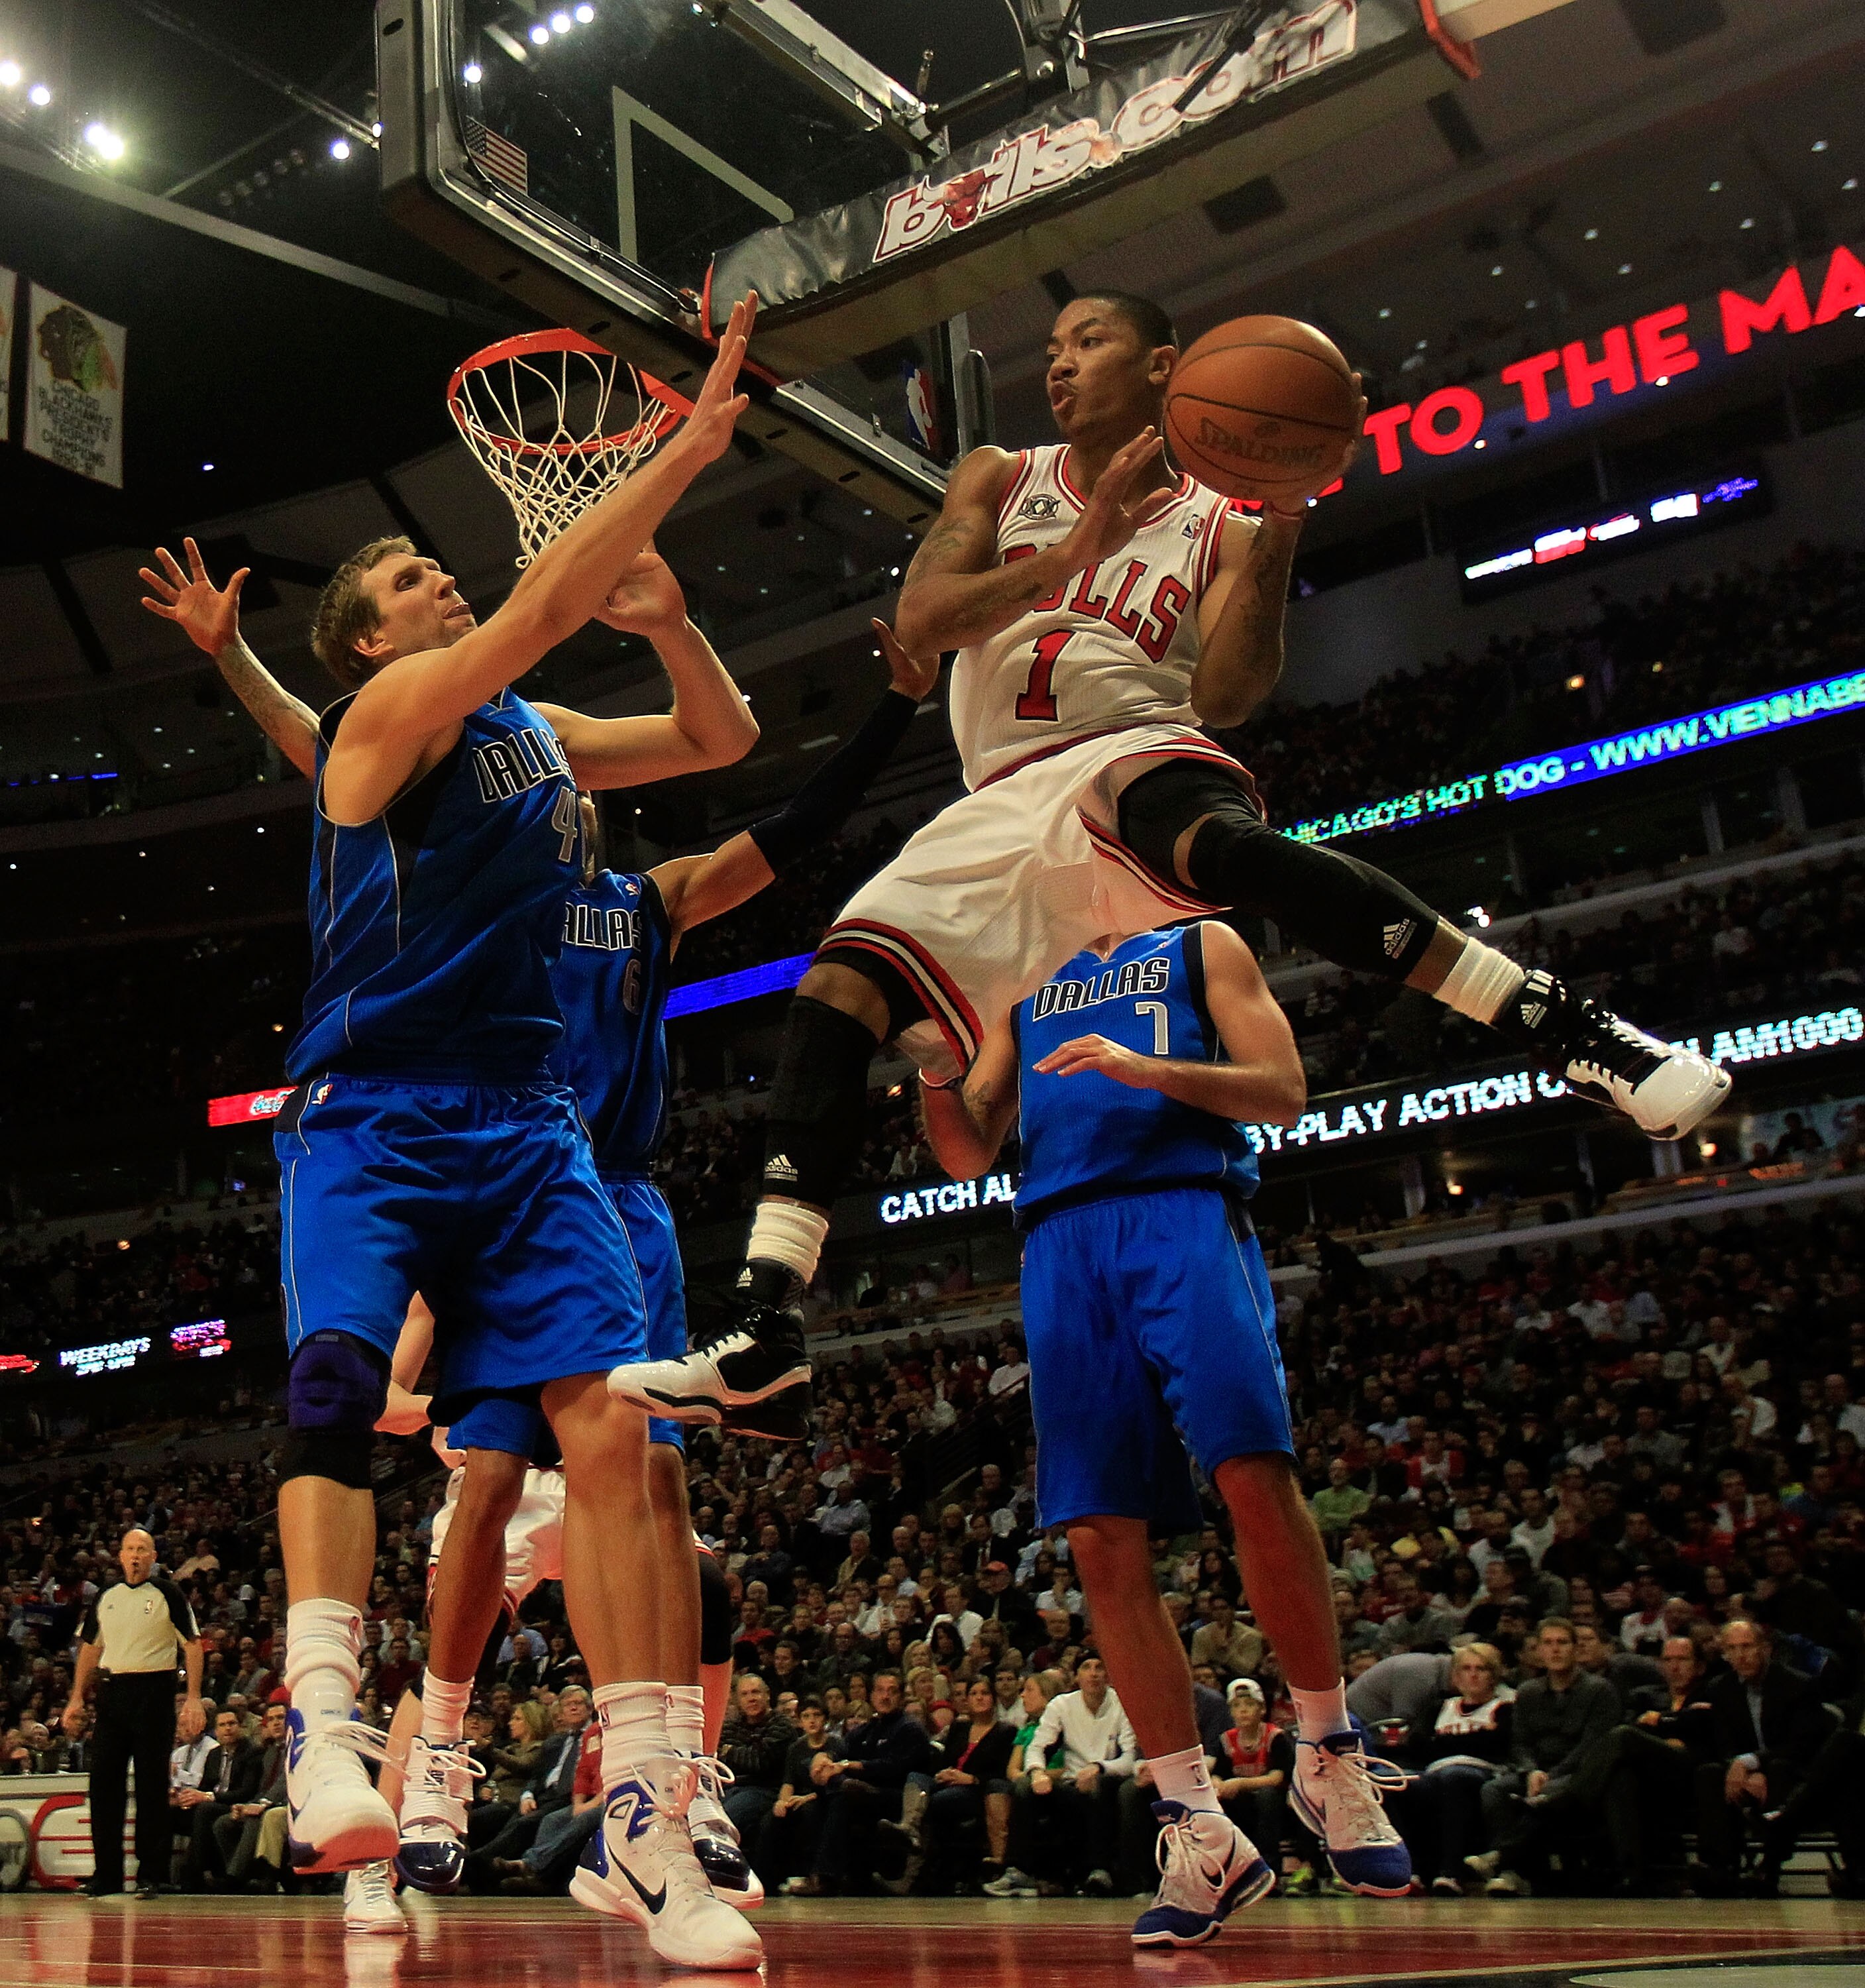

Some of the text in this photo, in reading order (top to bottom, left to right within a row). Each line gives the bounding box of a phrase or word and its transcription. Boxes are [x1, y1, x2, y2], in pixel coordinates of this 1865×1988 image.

[1363, 386, 1484, 476] TO
[1501, 304, 1699, 423] THE
[1003, 543, 1191, 663] LLS
[1015, 628, 1075, 723] 1
[1423, 773, 1486, 812] HOT
[1494, 756, 1566, 795] DOG
[1032, 957, 1171, 1022] DALLAS
[1134, 1001, 1169, 1055] 7
[1399, 1071, 1531, 1127] ACTION
[765, 1165, 798, 1176] adidas
[880, 1180, 978, 1223] CATCH
